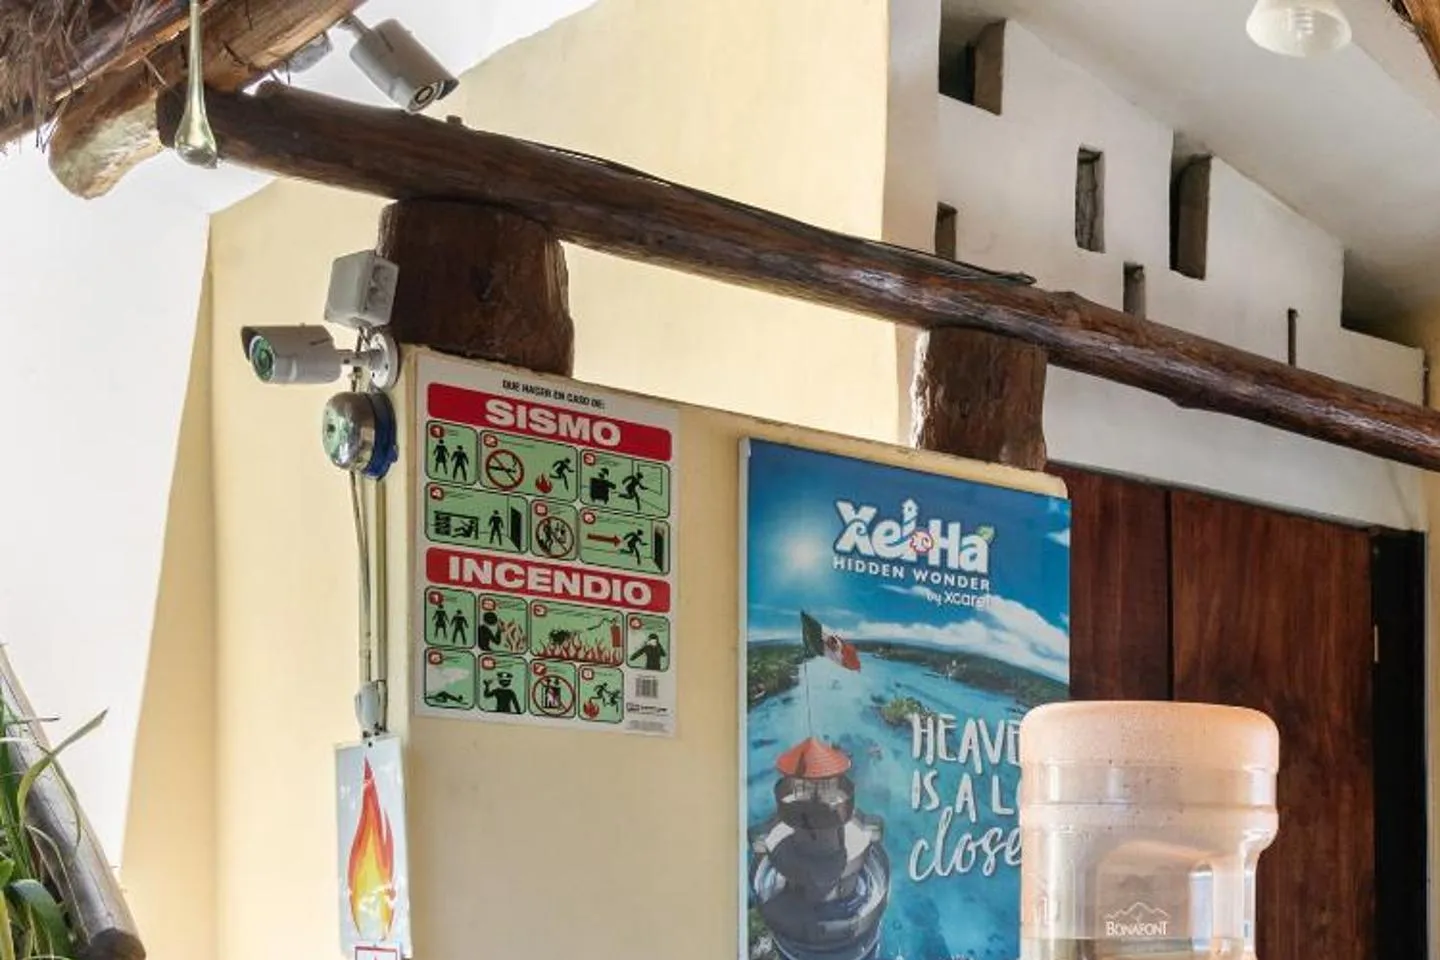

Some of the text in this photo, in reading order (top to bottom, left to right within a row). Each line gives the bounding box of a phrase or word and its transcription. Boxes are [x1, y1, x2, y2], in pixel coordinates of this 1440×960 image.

[485, 399, 621, 446] SISMO
[449, 556, 652, 605] INCENDIO
[833, 557, 990, 590] HIDDEN WONDER
[926, 592, 942, 607] by
[907, 712, 1022, 774] HEAVE
[911, 769, 940, 811] IS
[955, 772, 977, 823] A
[909, 805, 1022, 882] close
